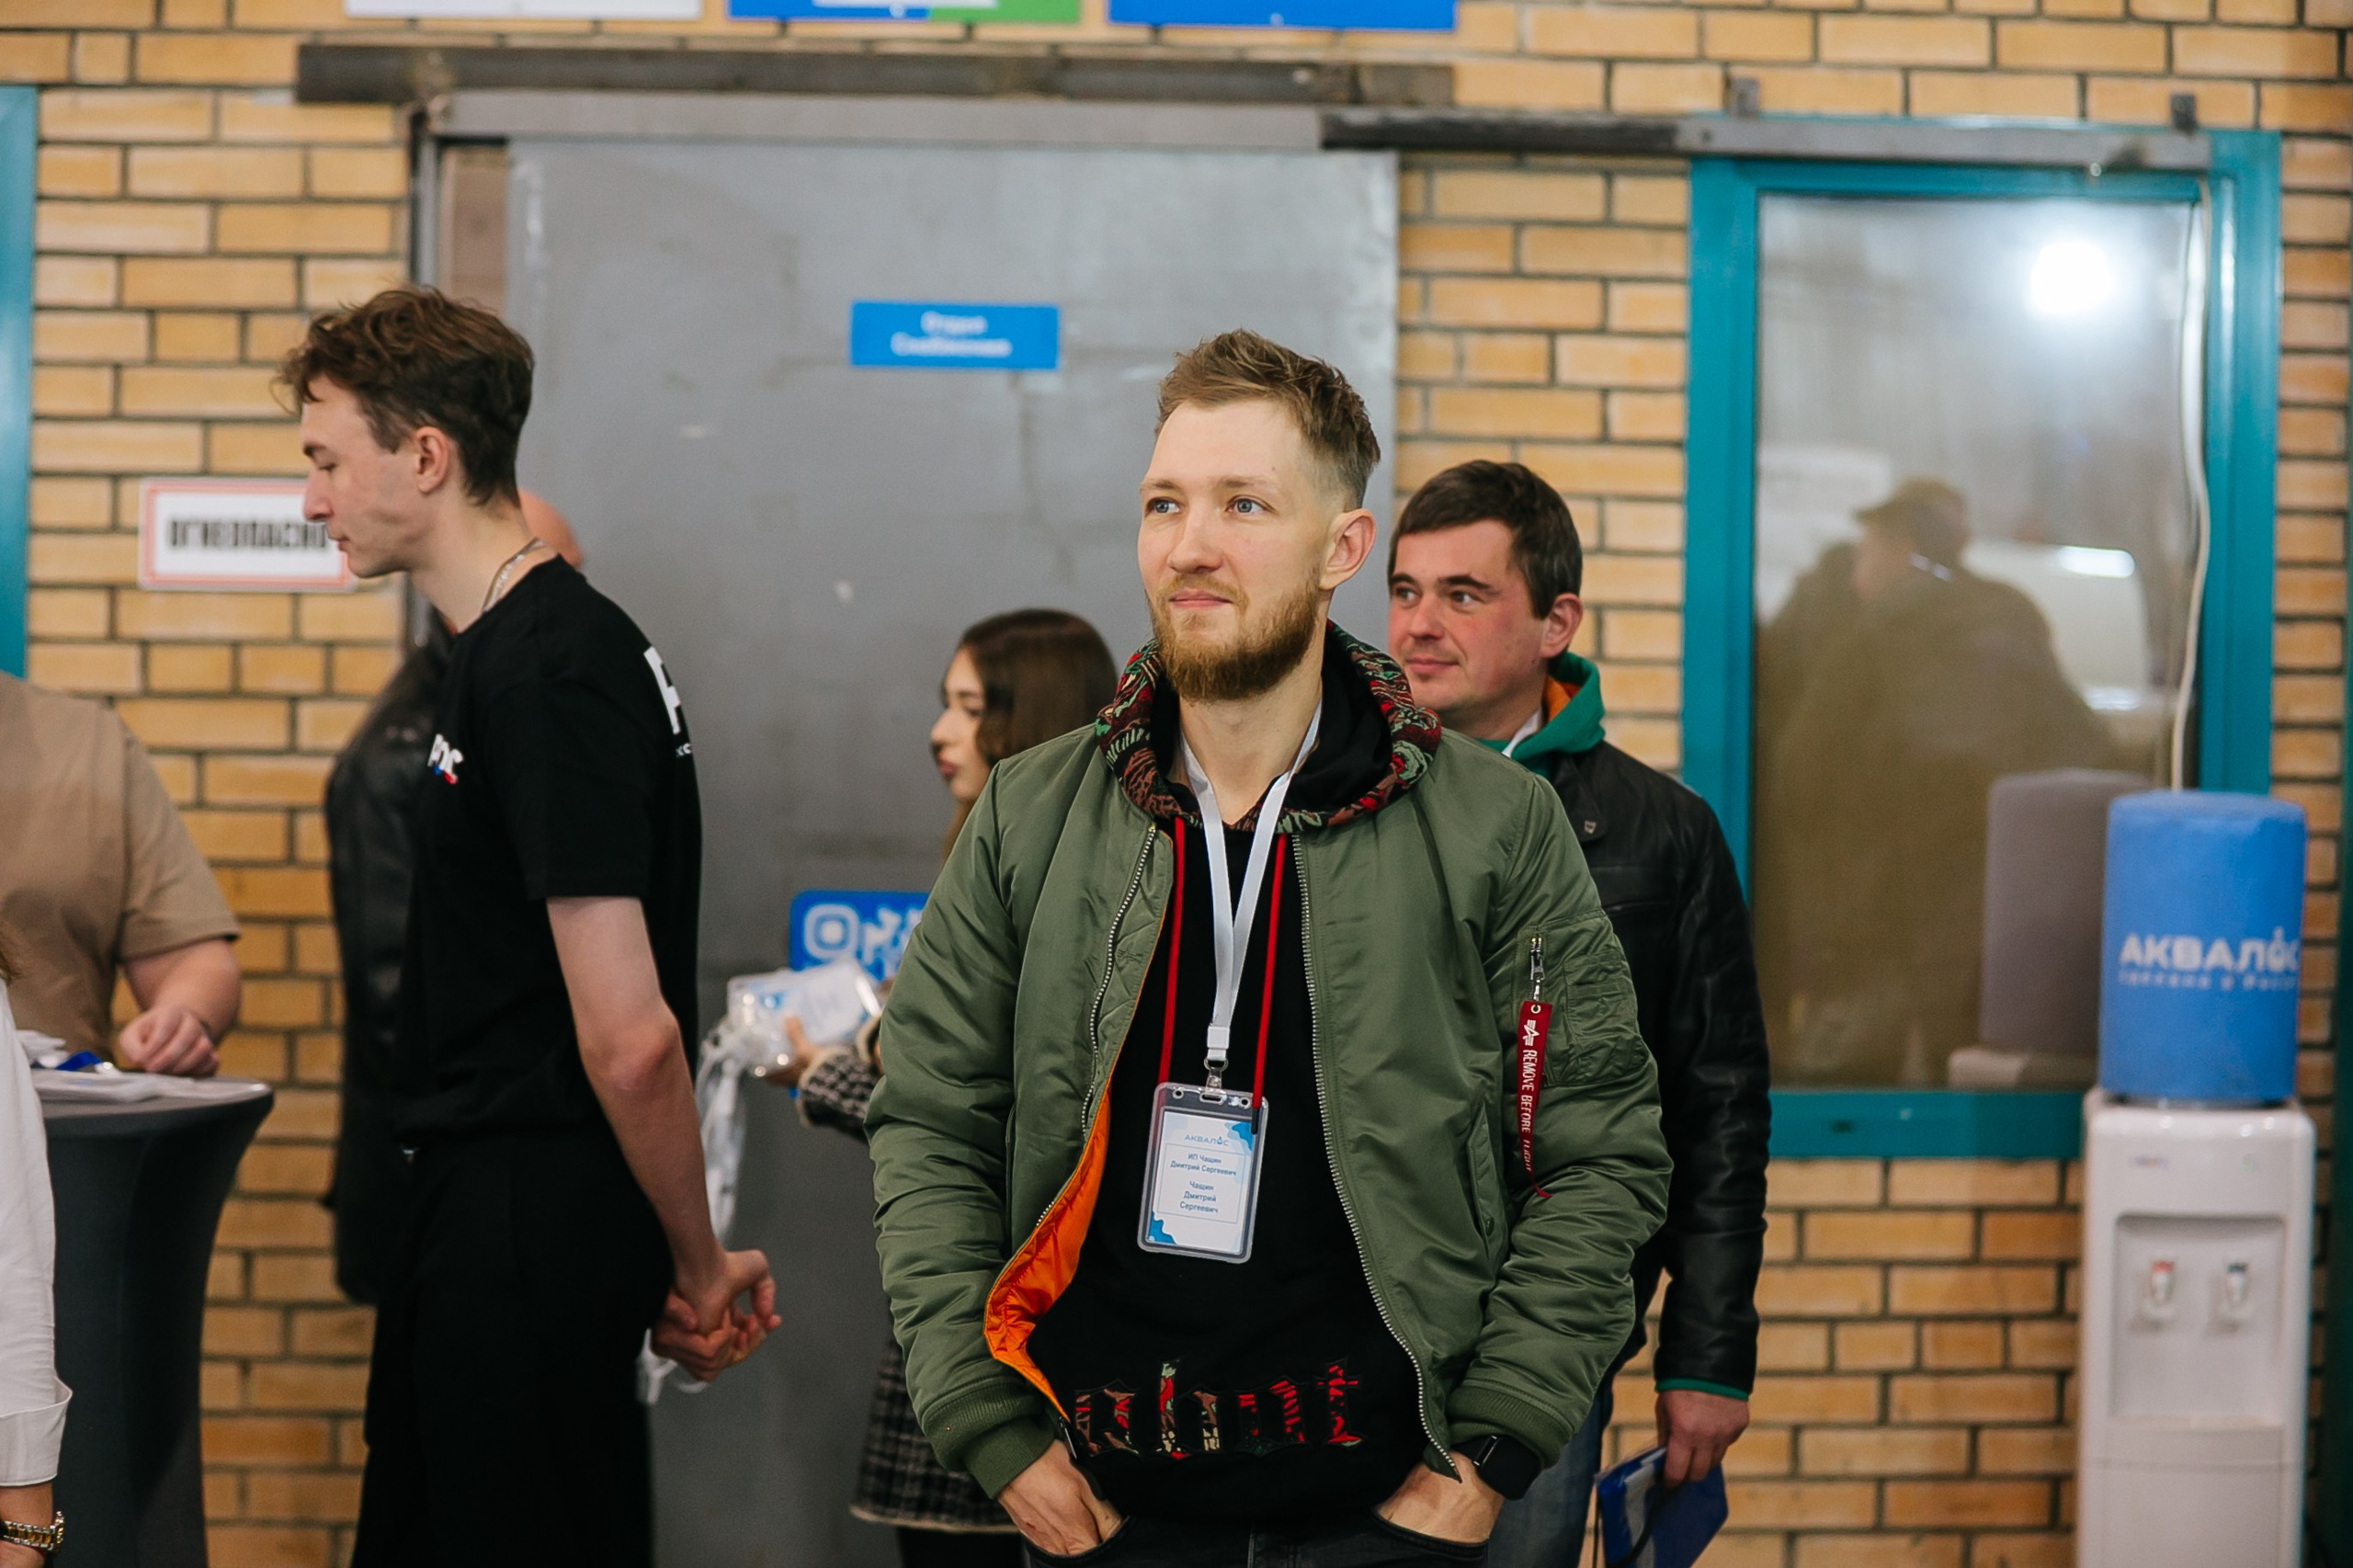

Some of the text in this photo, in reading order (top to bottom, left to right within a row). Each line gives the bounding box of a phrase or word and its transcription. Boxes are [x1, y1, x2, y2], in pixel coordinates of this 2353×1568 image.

[1521, 1049, 1538, 1092] REMOVE
[1520, 1095, 1533, 1133] BEFORE
[1188, 1153, 1222, 1164] ИП Чащин
[1170, 1160, 1237, 1176] Дмитрий Сергеевич
[1189, 1180, 1214, 1191] Чащин
[1183, 1190, 1217, 1202] Дмитрий
[1179, 1200, 1219, 1213] Сергеевич
